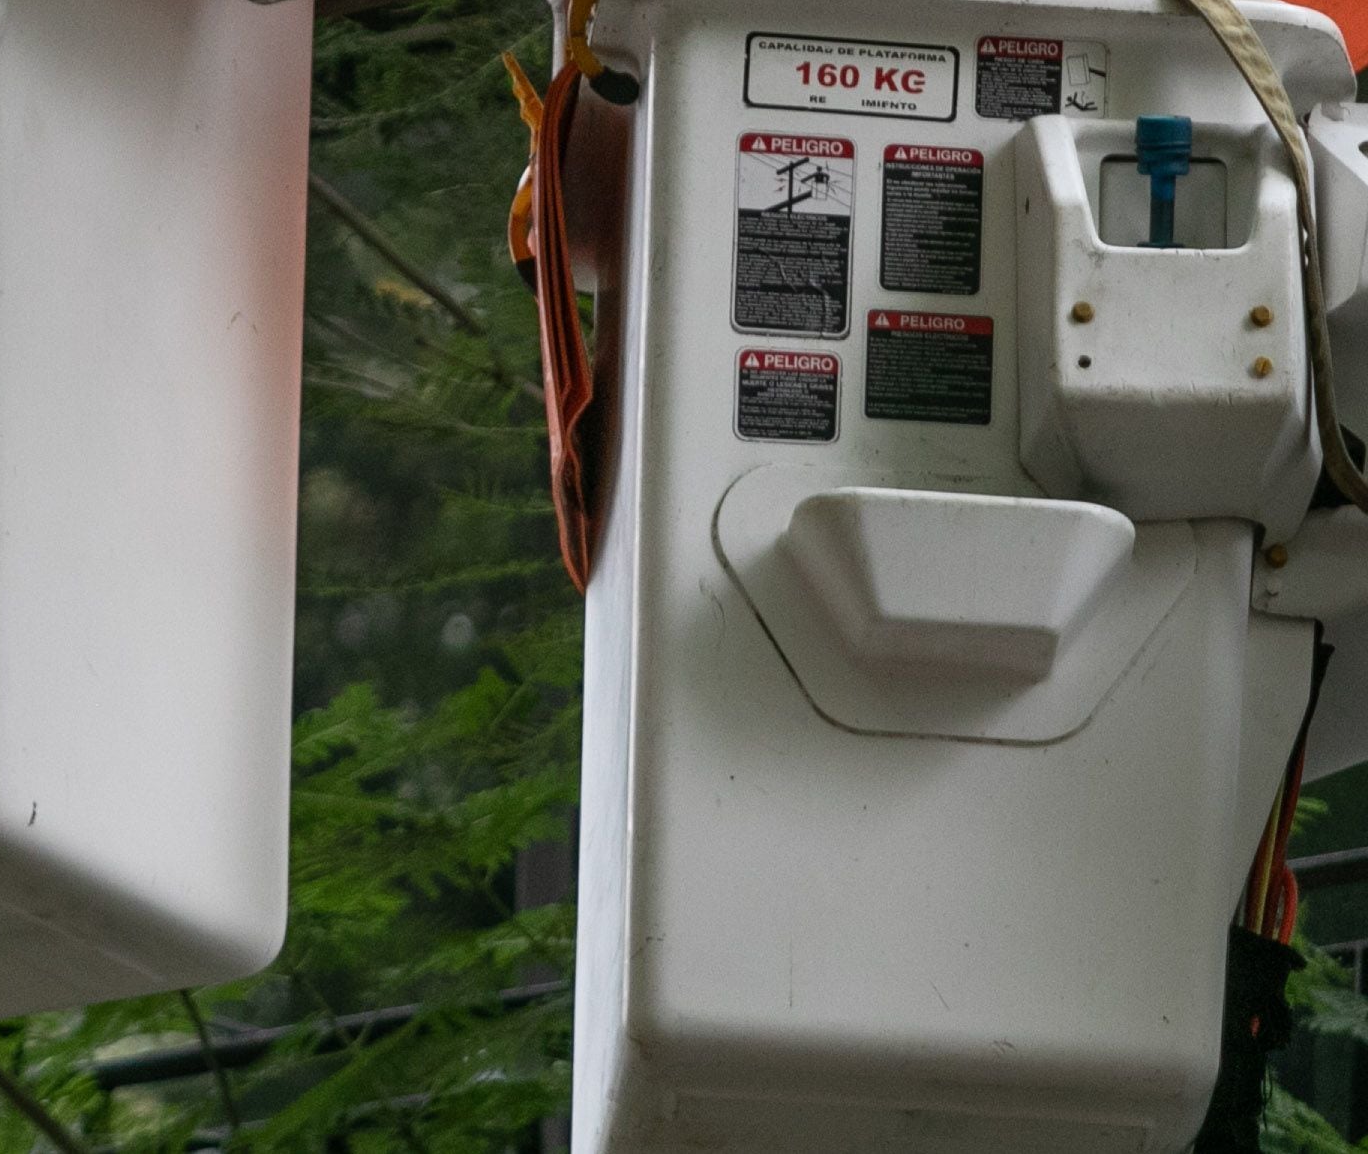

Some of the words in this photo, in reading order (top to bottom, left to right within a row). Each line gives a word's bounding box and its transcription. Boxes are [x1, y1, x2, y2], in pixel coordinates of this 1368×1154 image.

[837, 46, 854, 56] DE
[859, 49, 946, 63] PLATAFORMA
[998, 39, 1059, 56] PELIGRO
[796, 61, 860, 89] 160
[874, 66, 926, 94] KG
[771, 137, 843, 155] PELIGRO
[910, 148, 972, 162] PELIGRO
[900, 314, 965, 330] PELIGRO
[764, 354, 833, 371] PELIGRO
